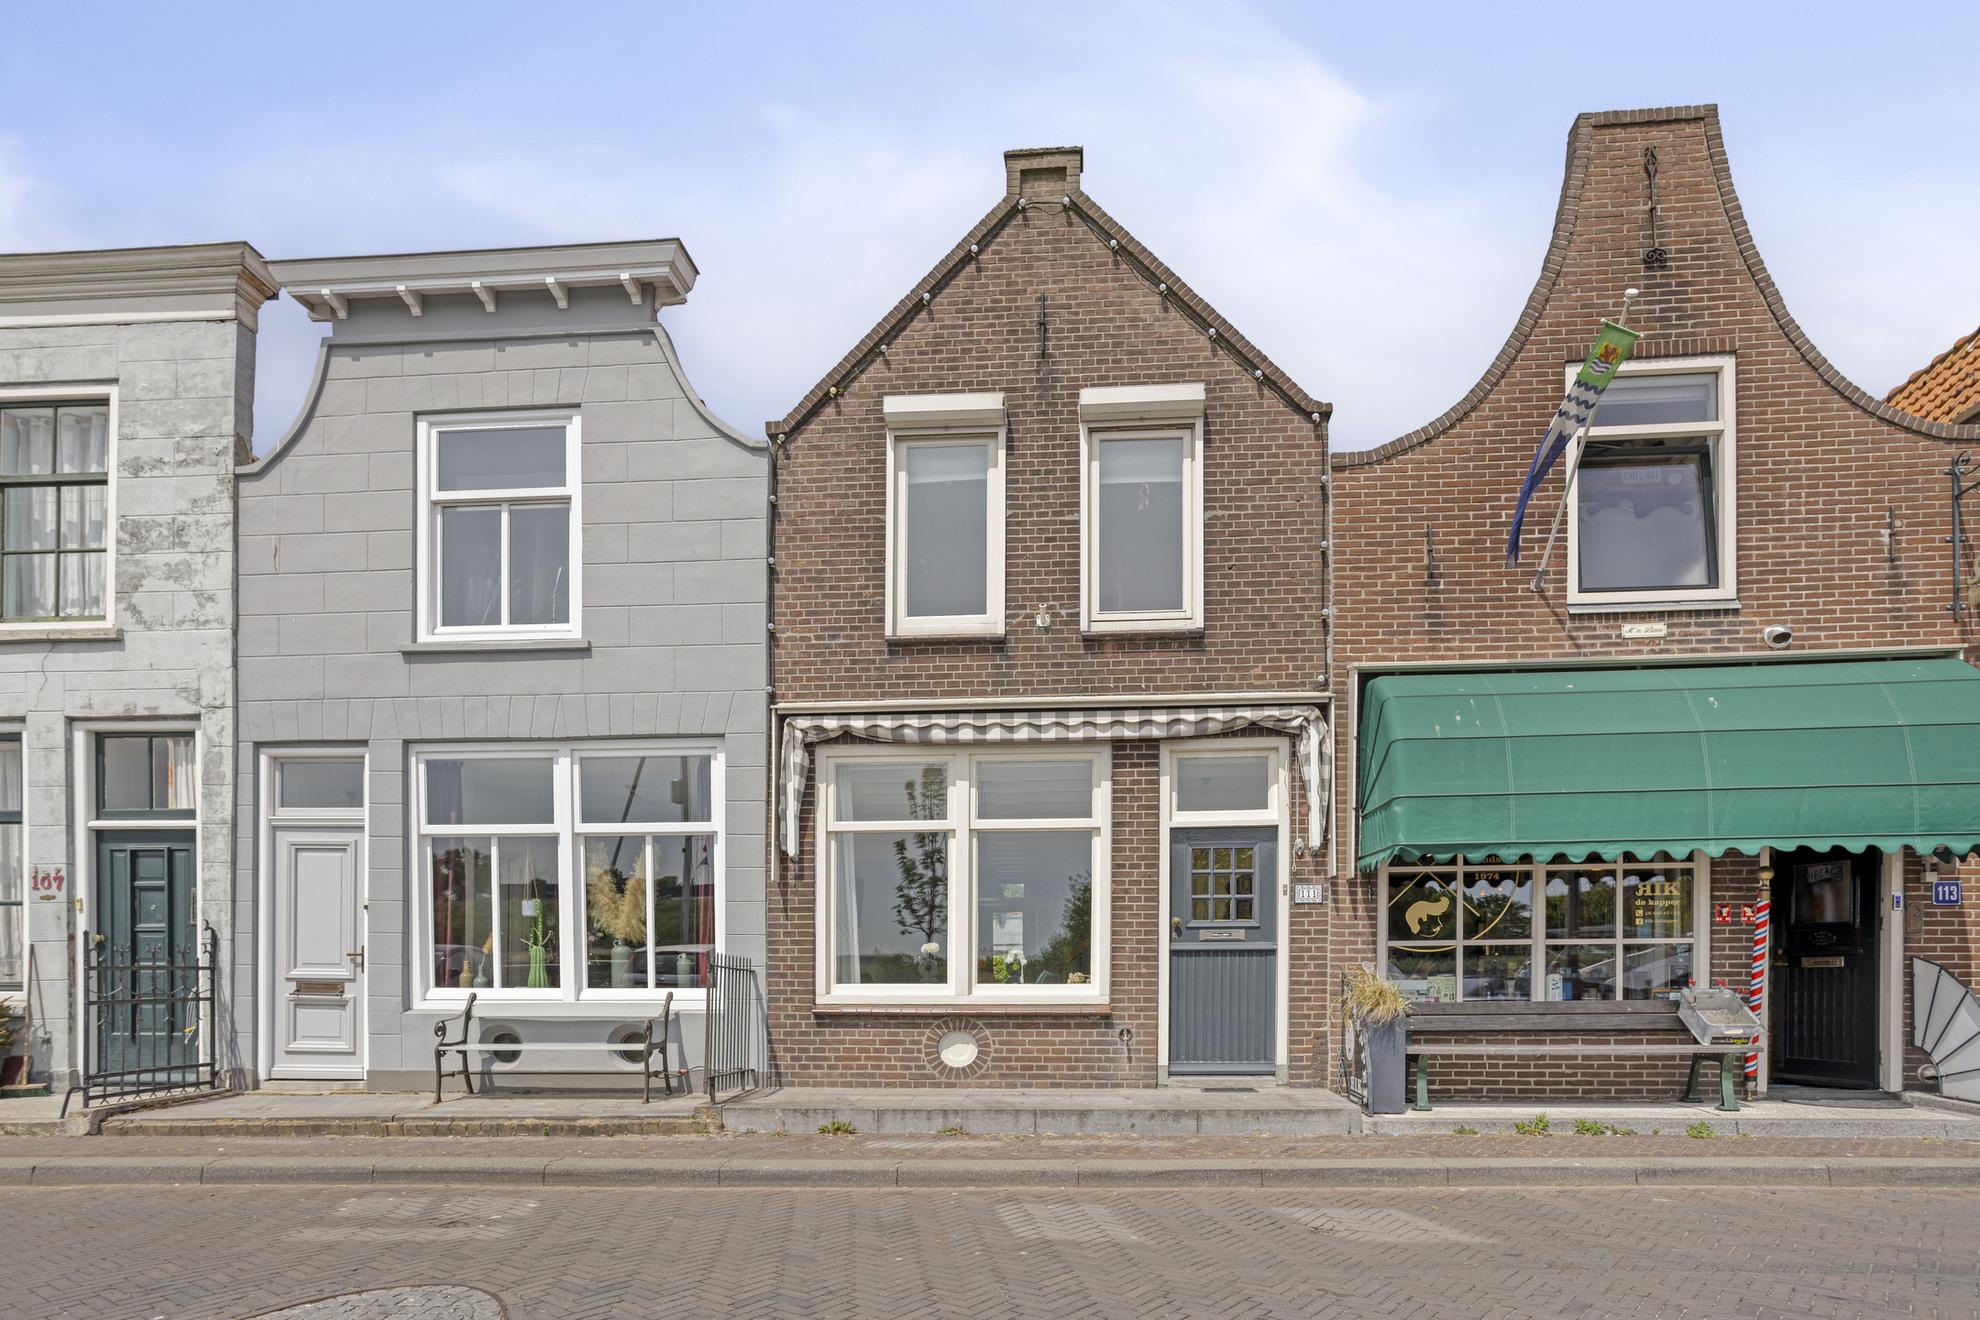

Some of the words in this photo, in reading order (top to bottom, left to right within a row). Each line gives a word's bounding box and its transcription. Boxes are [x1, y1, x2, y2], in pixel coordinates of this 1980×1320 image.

[1474, 872, 1500, 880] 1974
[31, 876, 65, 891] 107
[1301, 889, 1317, 898] 111
[1937, 885, 1958, 901] 113
[1635, 898, 1646, 906] de
[1648, 898, 1680, 907] kapper
